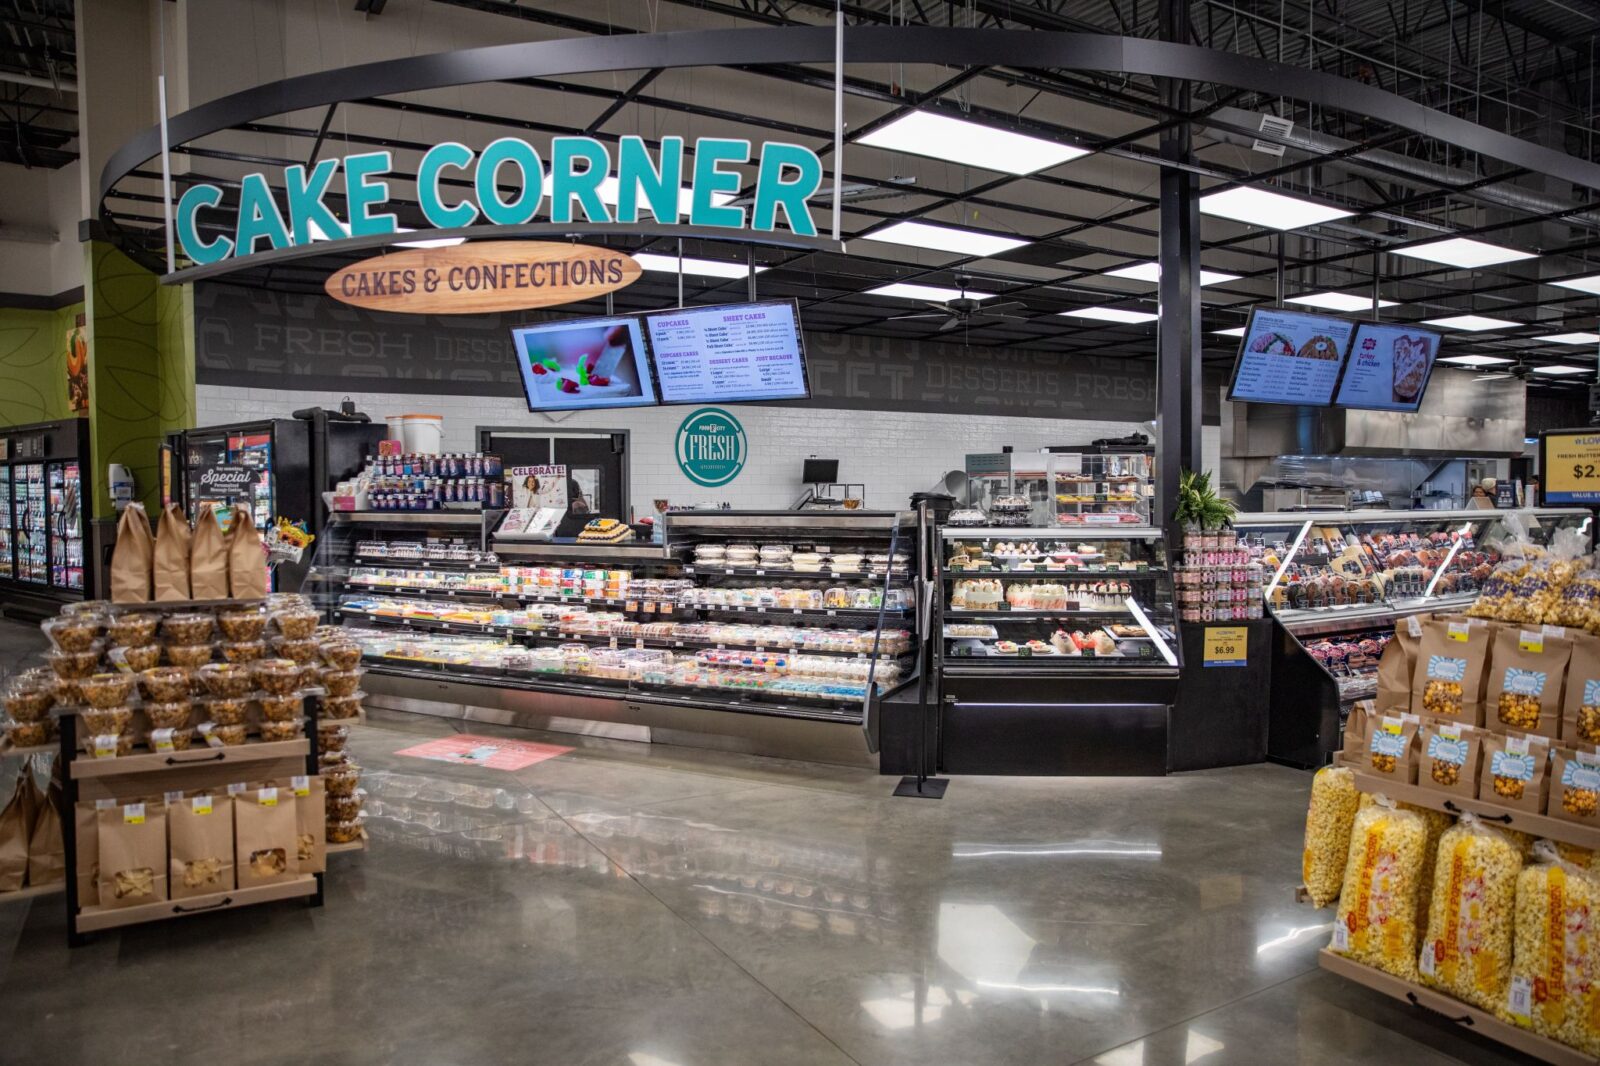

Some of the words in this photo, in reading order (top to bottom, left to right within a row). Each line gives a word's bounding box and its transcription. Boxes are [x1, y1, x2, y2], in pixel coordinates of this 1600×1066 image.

[176, 150, 399, 266] CAKE
[417, 135, 824, 238] CORNER
[341, 270, 416, 297] CAKES
[424, 268, 440, 293] &
[449, 258, 624, 291] CONFECTIONS
[657, 319, 689, 327] CUPCAKES
[744, 312, 766, 320] CAKES
[254, 322, 413, 360] FRESH
[925, 361, 1060, 397] DESSERTS
[689, 434, 735, 461] FRESH
[200, 468, 252, 485] Special
[512, 465, 565, 476] CELEBRATE!
[1215, 646, 1235, 655] $6.99
[1449, 854, 1463, 907] POPCORN
[1550, 884, 1563, 942] POPCORN
[1446, 919, 1458, 950] HEAP
[1550, 956, 1563, 991] HEAP
